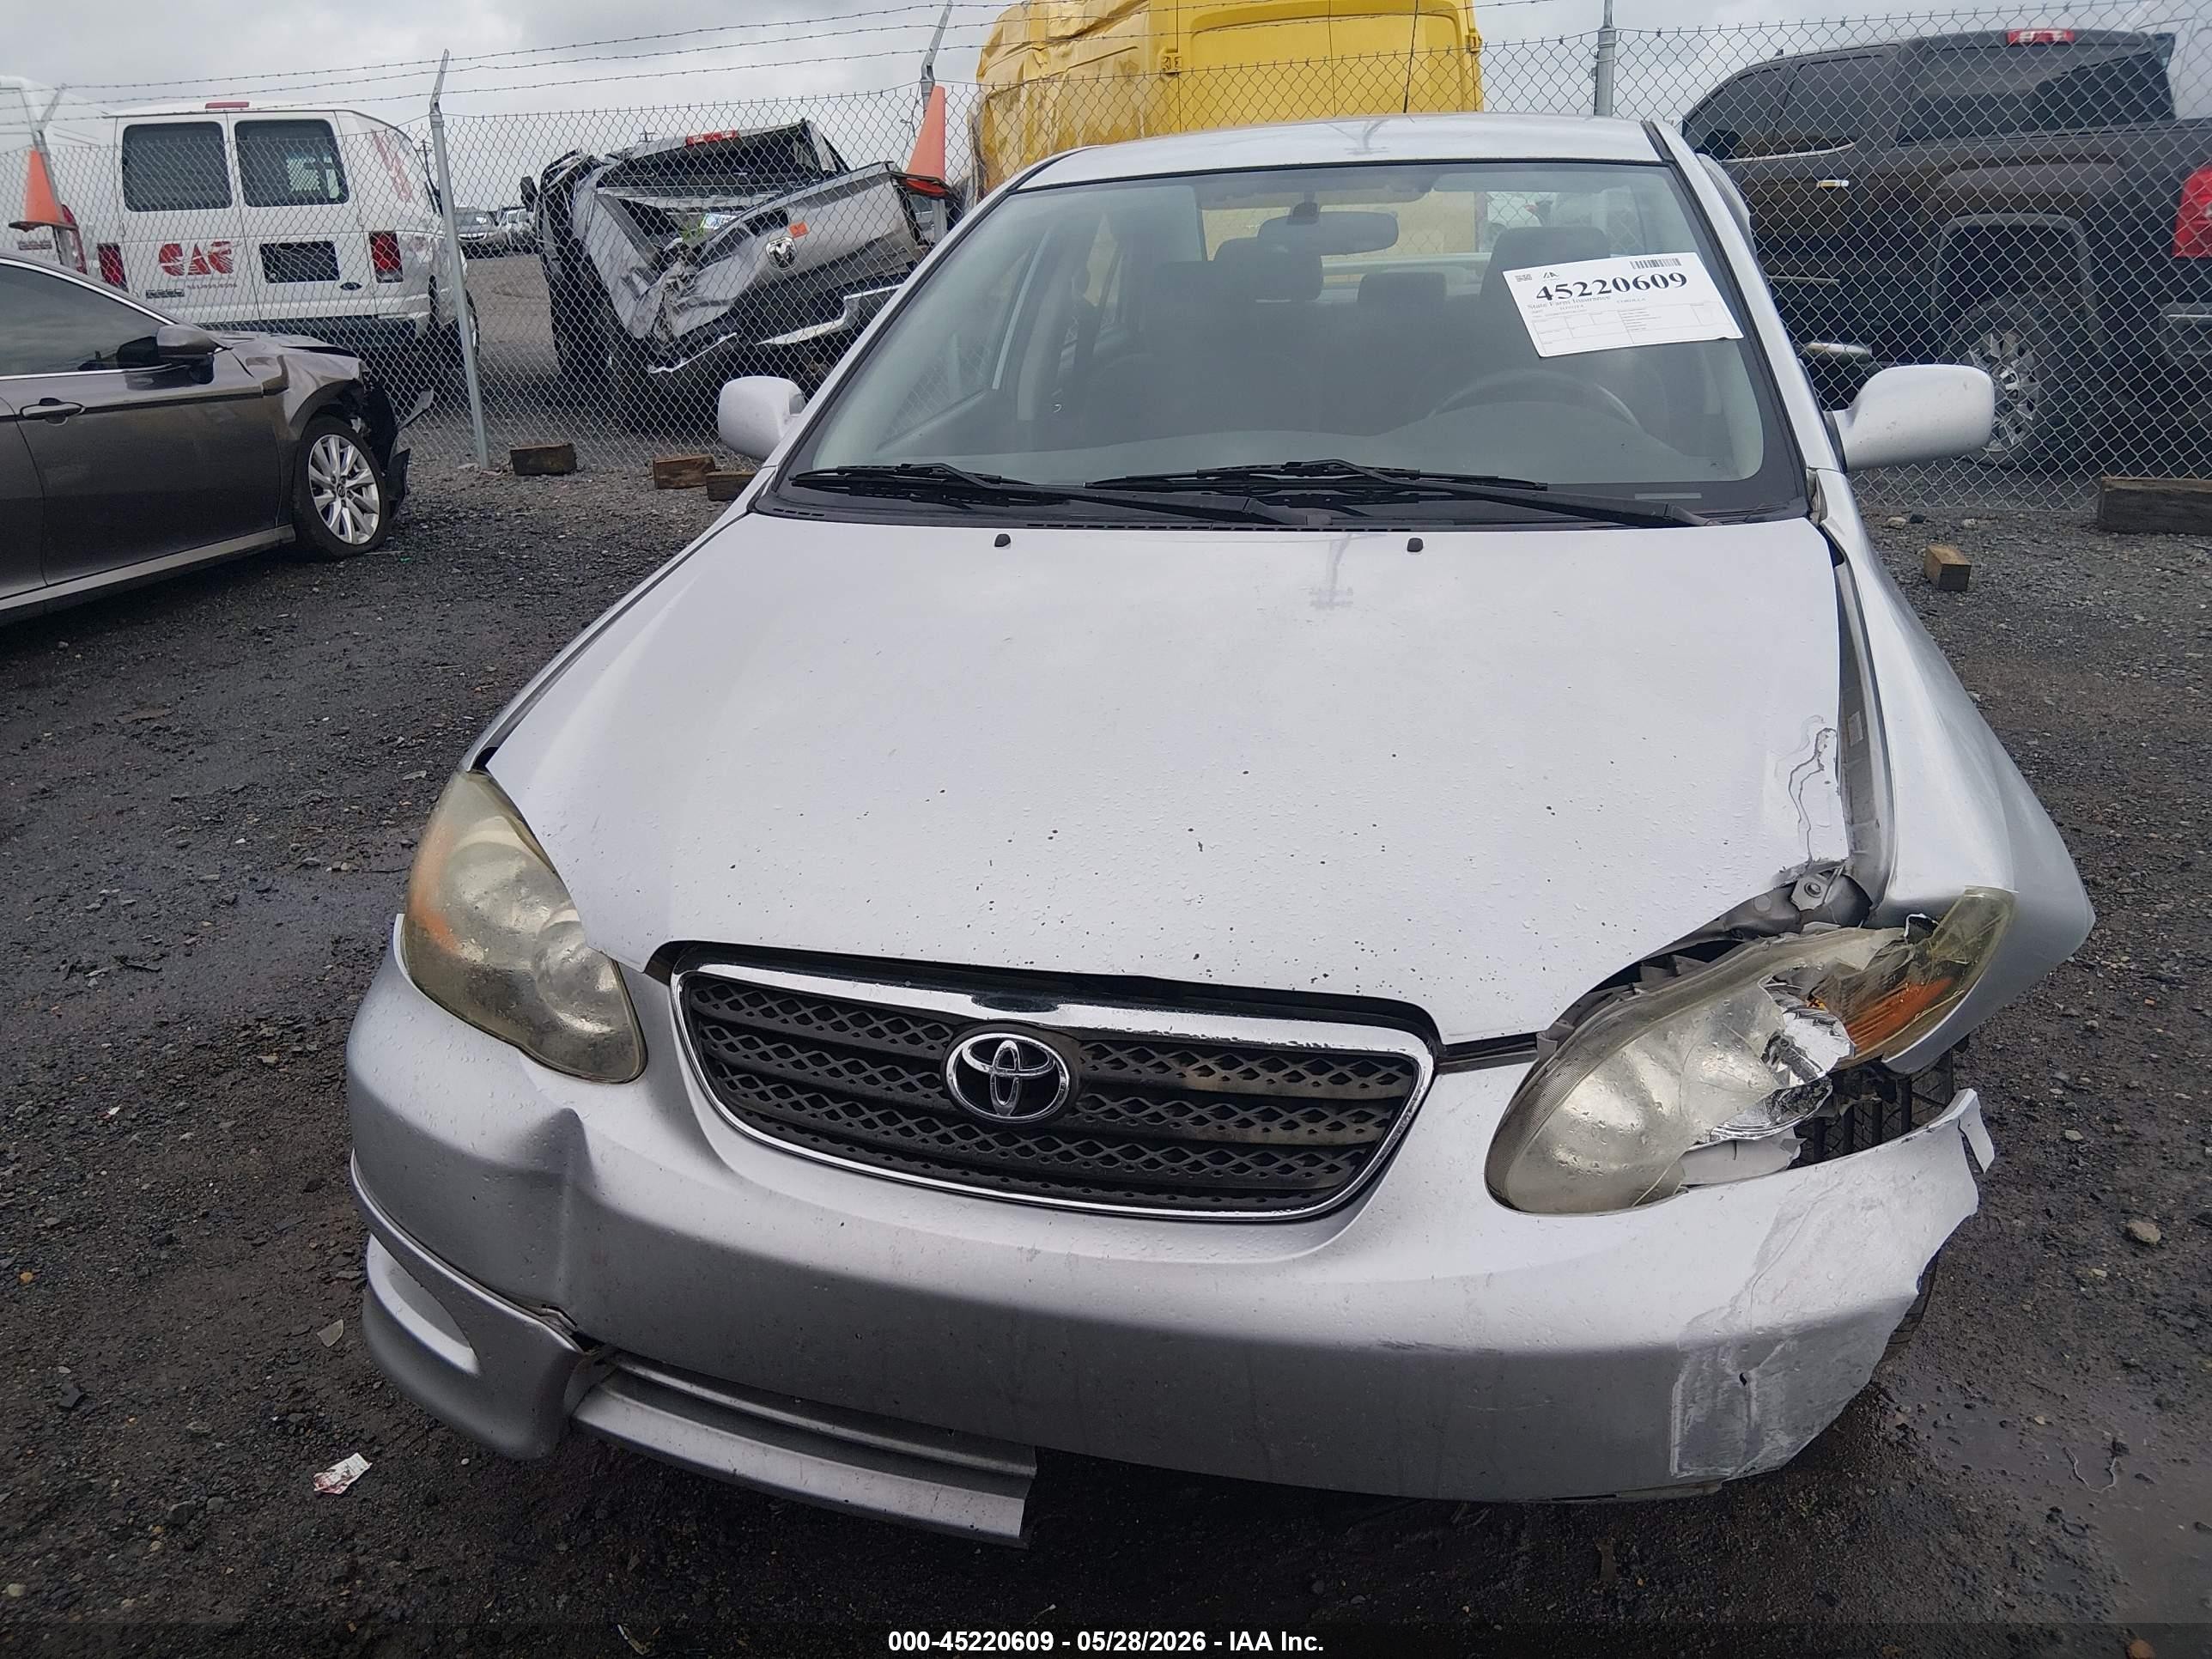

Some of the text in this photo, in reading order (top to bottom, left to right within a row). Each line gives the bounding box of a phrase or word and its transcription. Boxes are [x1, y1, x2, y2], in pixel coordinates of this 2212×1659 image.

[1535, 271, 1688, 301] 45220609
[1527, 301, 1547, 310] State
[1572, 295, 1611, 305] Insurance
